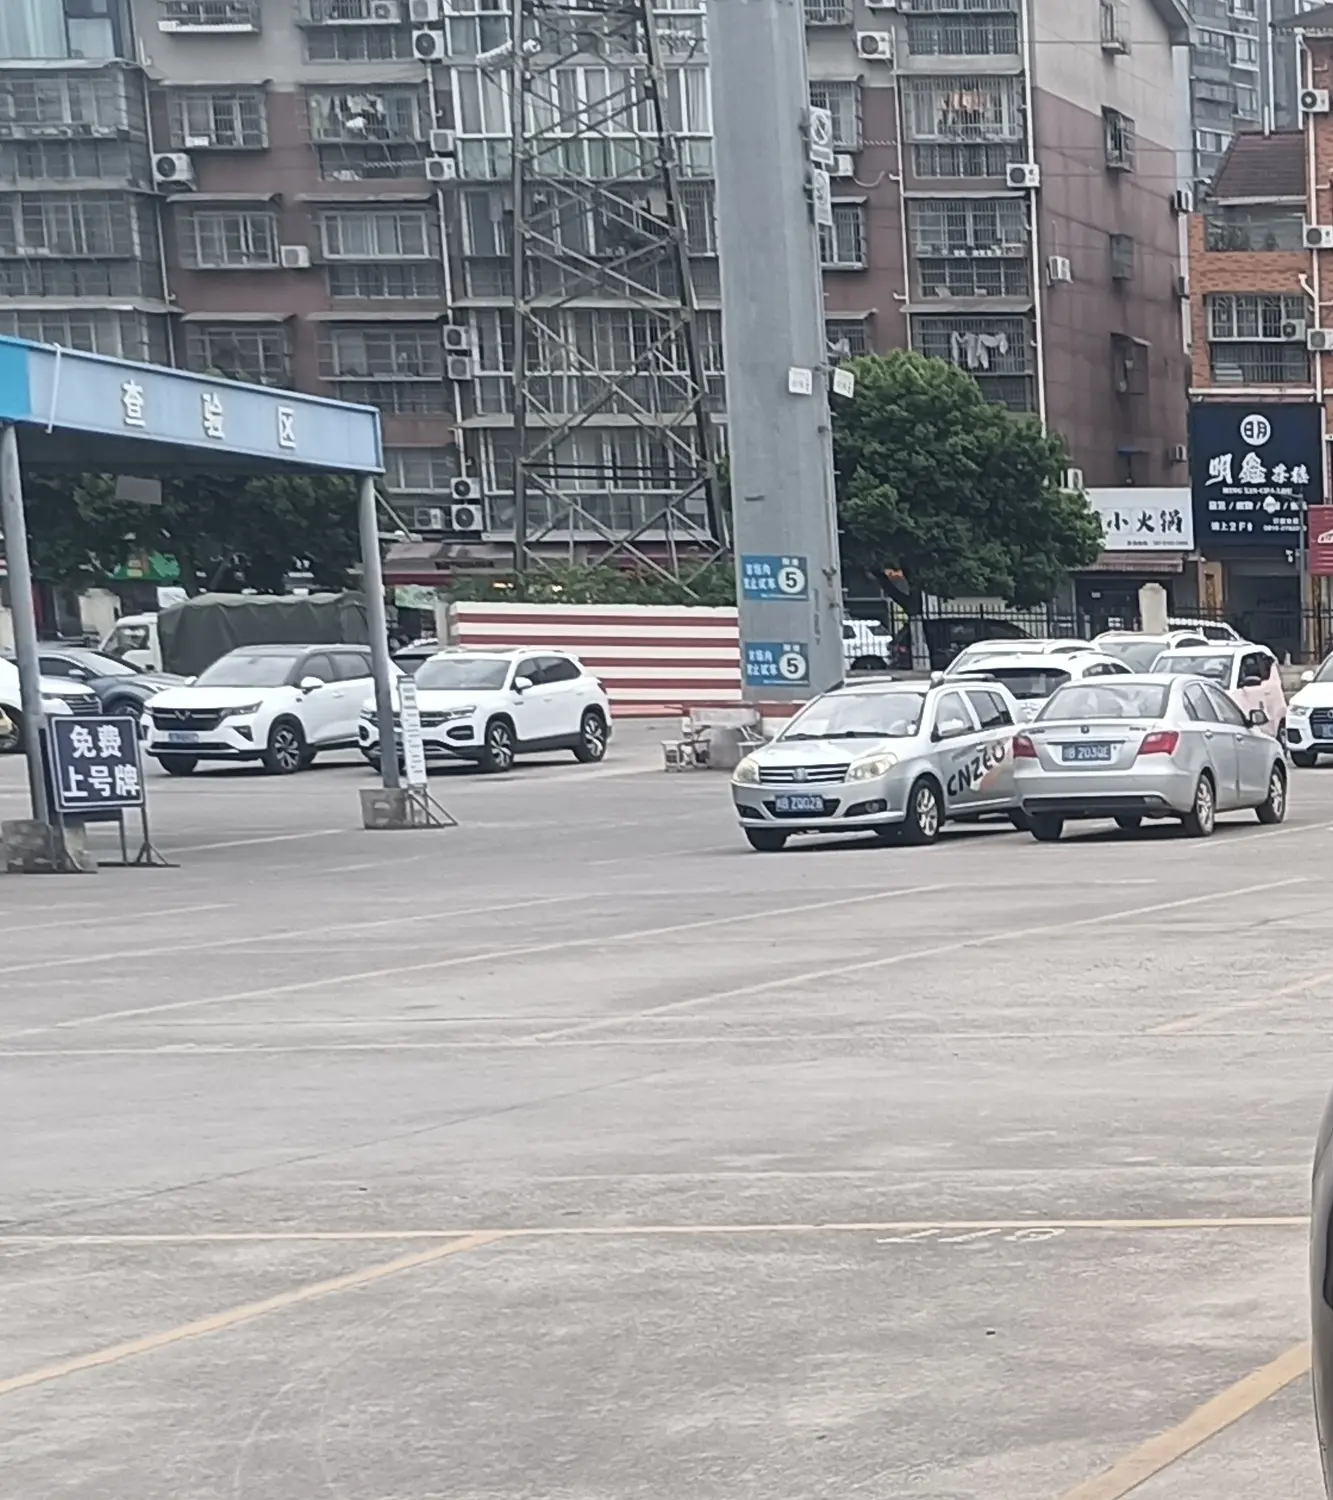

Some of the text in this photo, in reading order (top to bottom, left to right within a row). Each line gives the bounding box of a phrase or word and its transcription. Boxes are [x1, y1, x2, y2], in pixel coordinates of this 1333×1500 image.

[121, 379, 296, 449] 查验区
[785, 571, 798, 588] 5
[786, 657, 799, 675] 5
[70, 725, 122, 758] 免费
[63, 764, 140, 797] 上号牌
